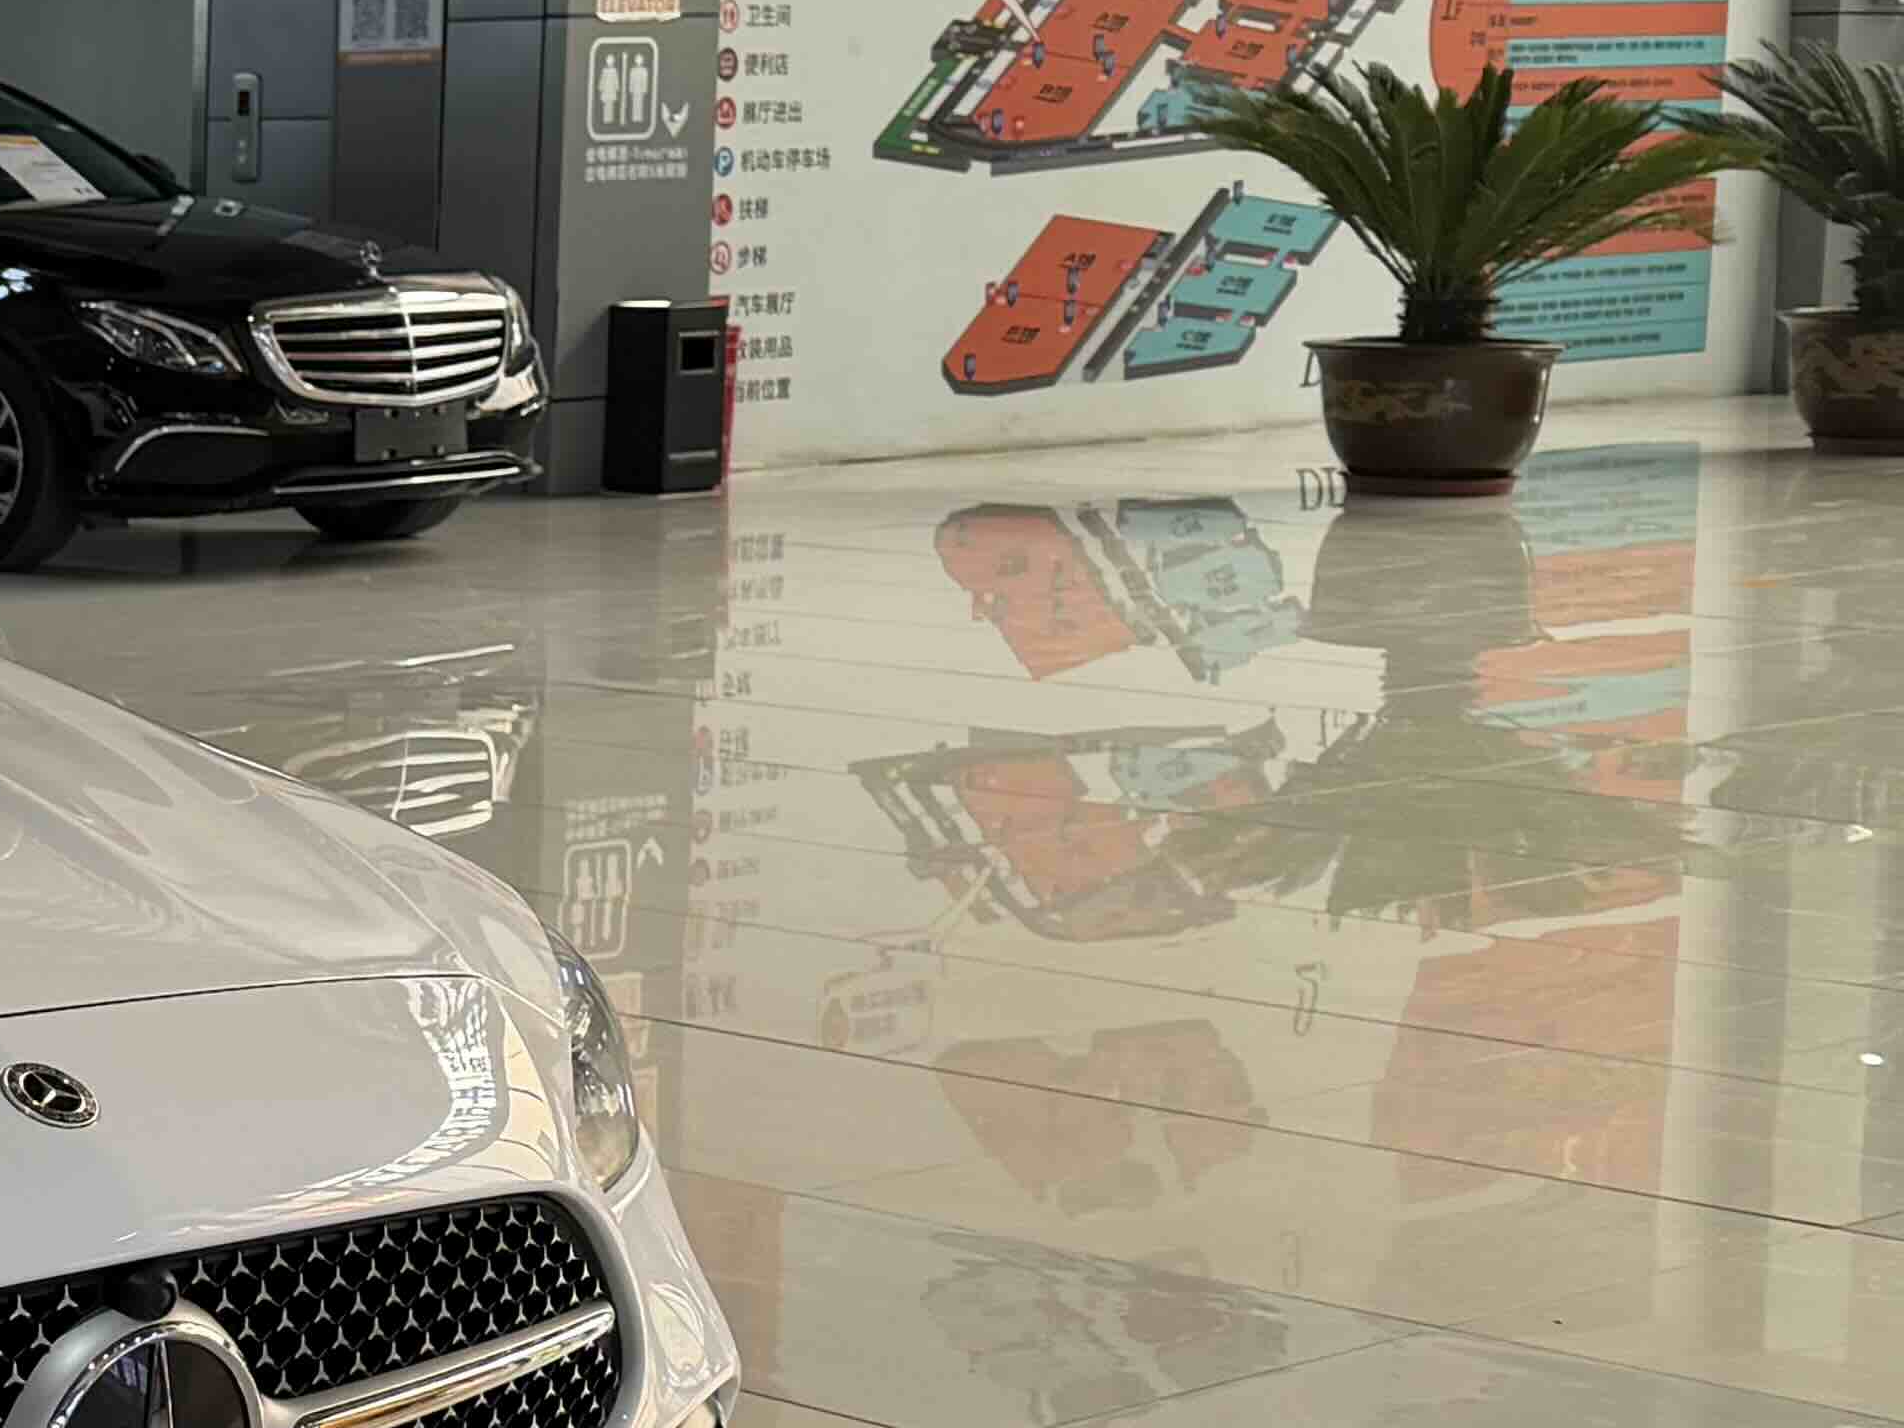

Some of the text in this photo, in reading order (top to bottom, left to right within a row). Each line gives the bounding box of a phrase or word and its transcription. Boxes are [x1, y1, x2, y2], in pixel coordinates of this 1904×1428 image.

[746, 4, 792, 27] 卫生间
[741, 146, 831, 172] 机动车停车场
[735, 292, 795, 317] 汽车展厅
